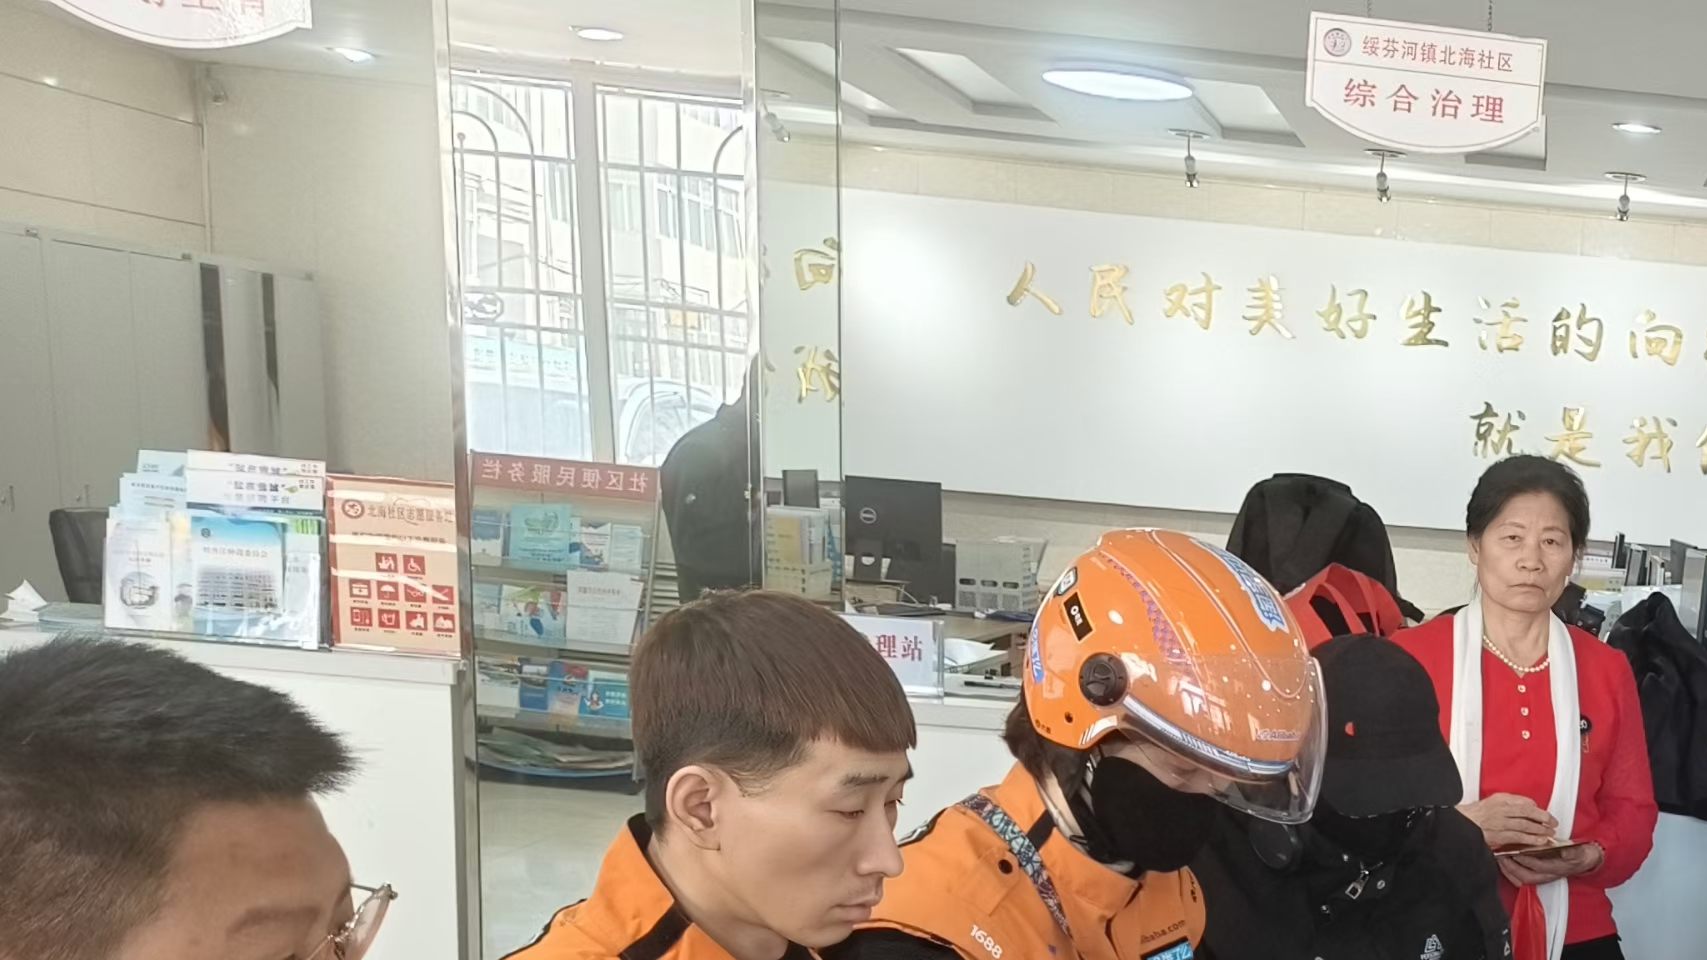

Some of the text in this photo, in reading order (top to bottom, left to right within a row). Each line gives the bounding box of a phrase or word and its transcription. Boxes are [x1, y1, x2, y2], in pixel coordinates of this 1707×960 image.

[1361, 34, 1514, 73] 绥芬河镇北海社区
[1342, 77, 1505, 125] 综合治理
[970, 924, 1003, 959] 1688
